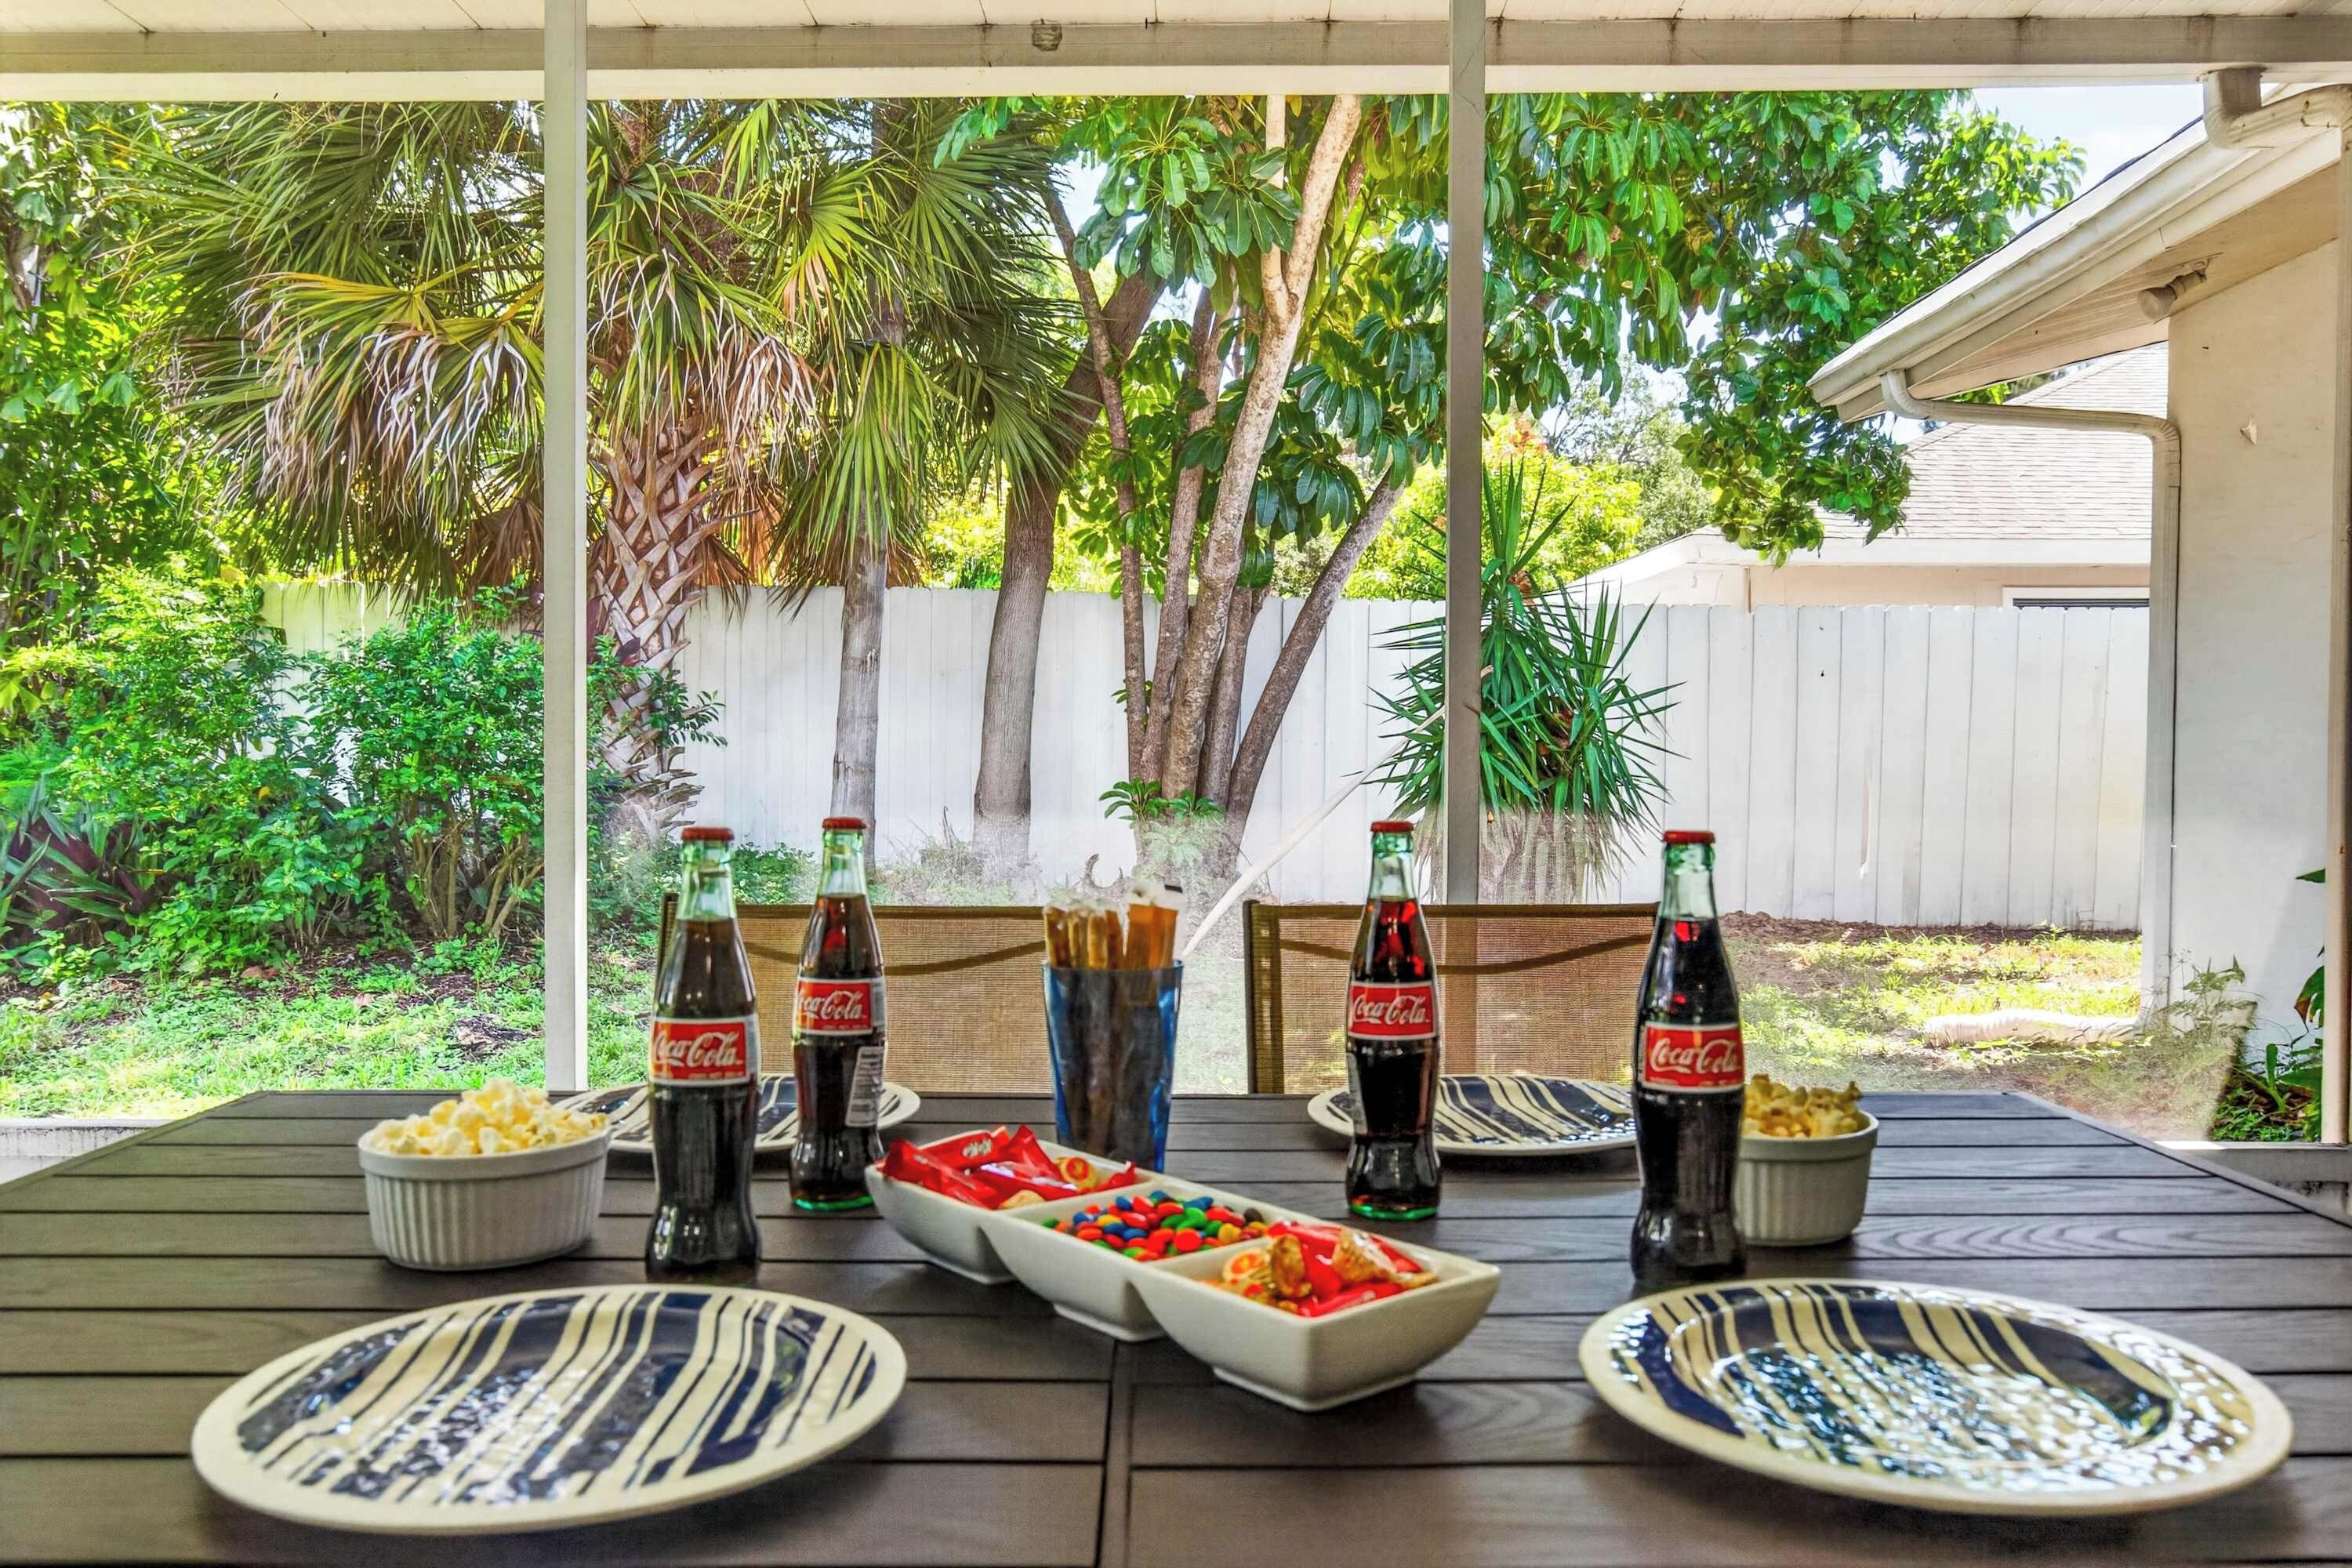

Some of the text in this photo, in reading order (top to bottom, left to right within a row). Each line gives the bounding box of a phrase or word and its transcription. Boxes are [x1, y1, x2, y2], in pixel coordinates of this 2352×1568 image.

[1353, 993, 1429, 1025] Coca-Cola
[653, 1029, 743, 1067] Coca-Cola
[1650, 1037, 1737, 1074] Coca-Cola
